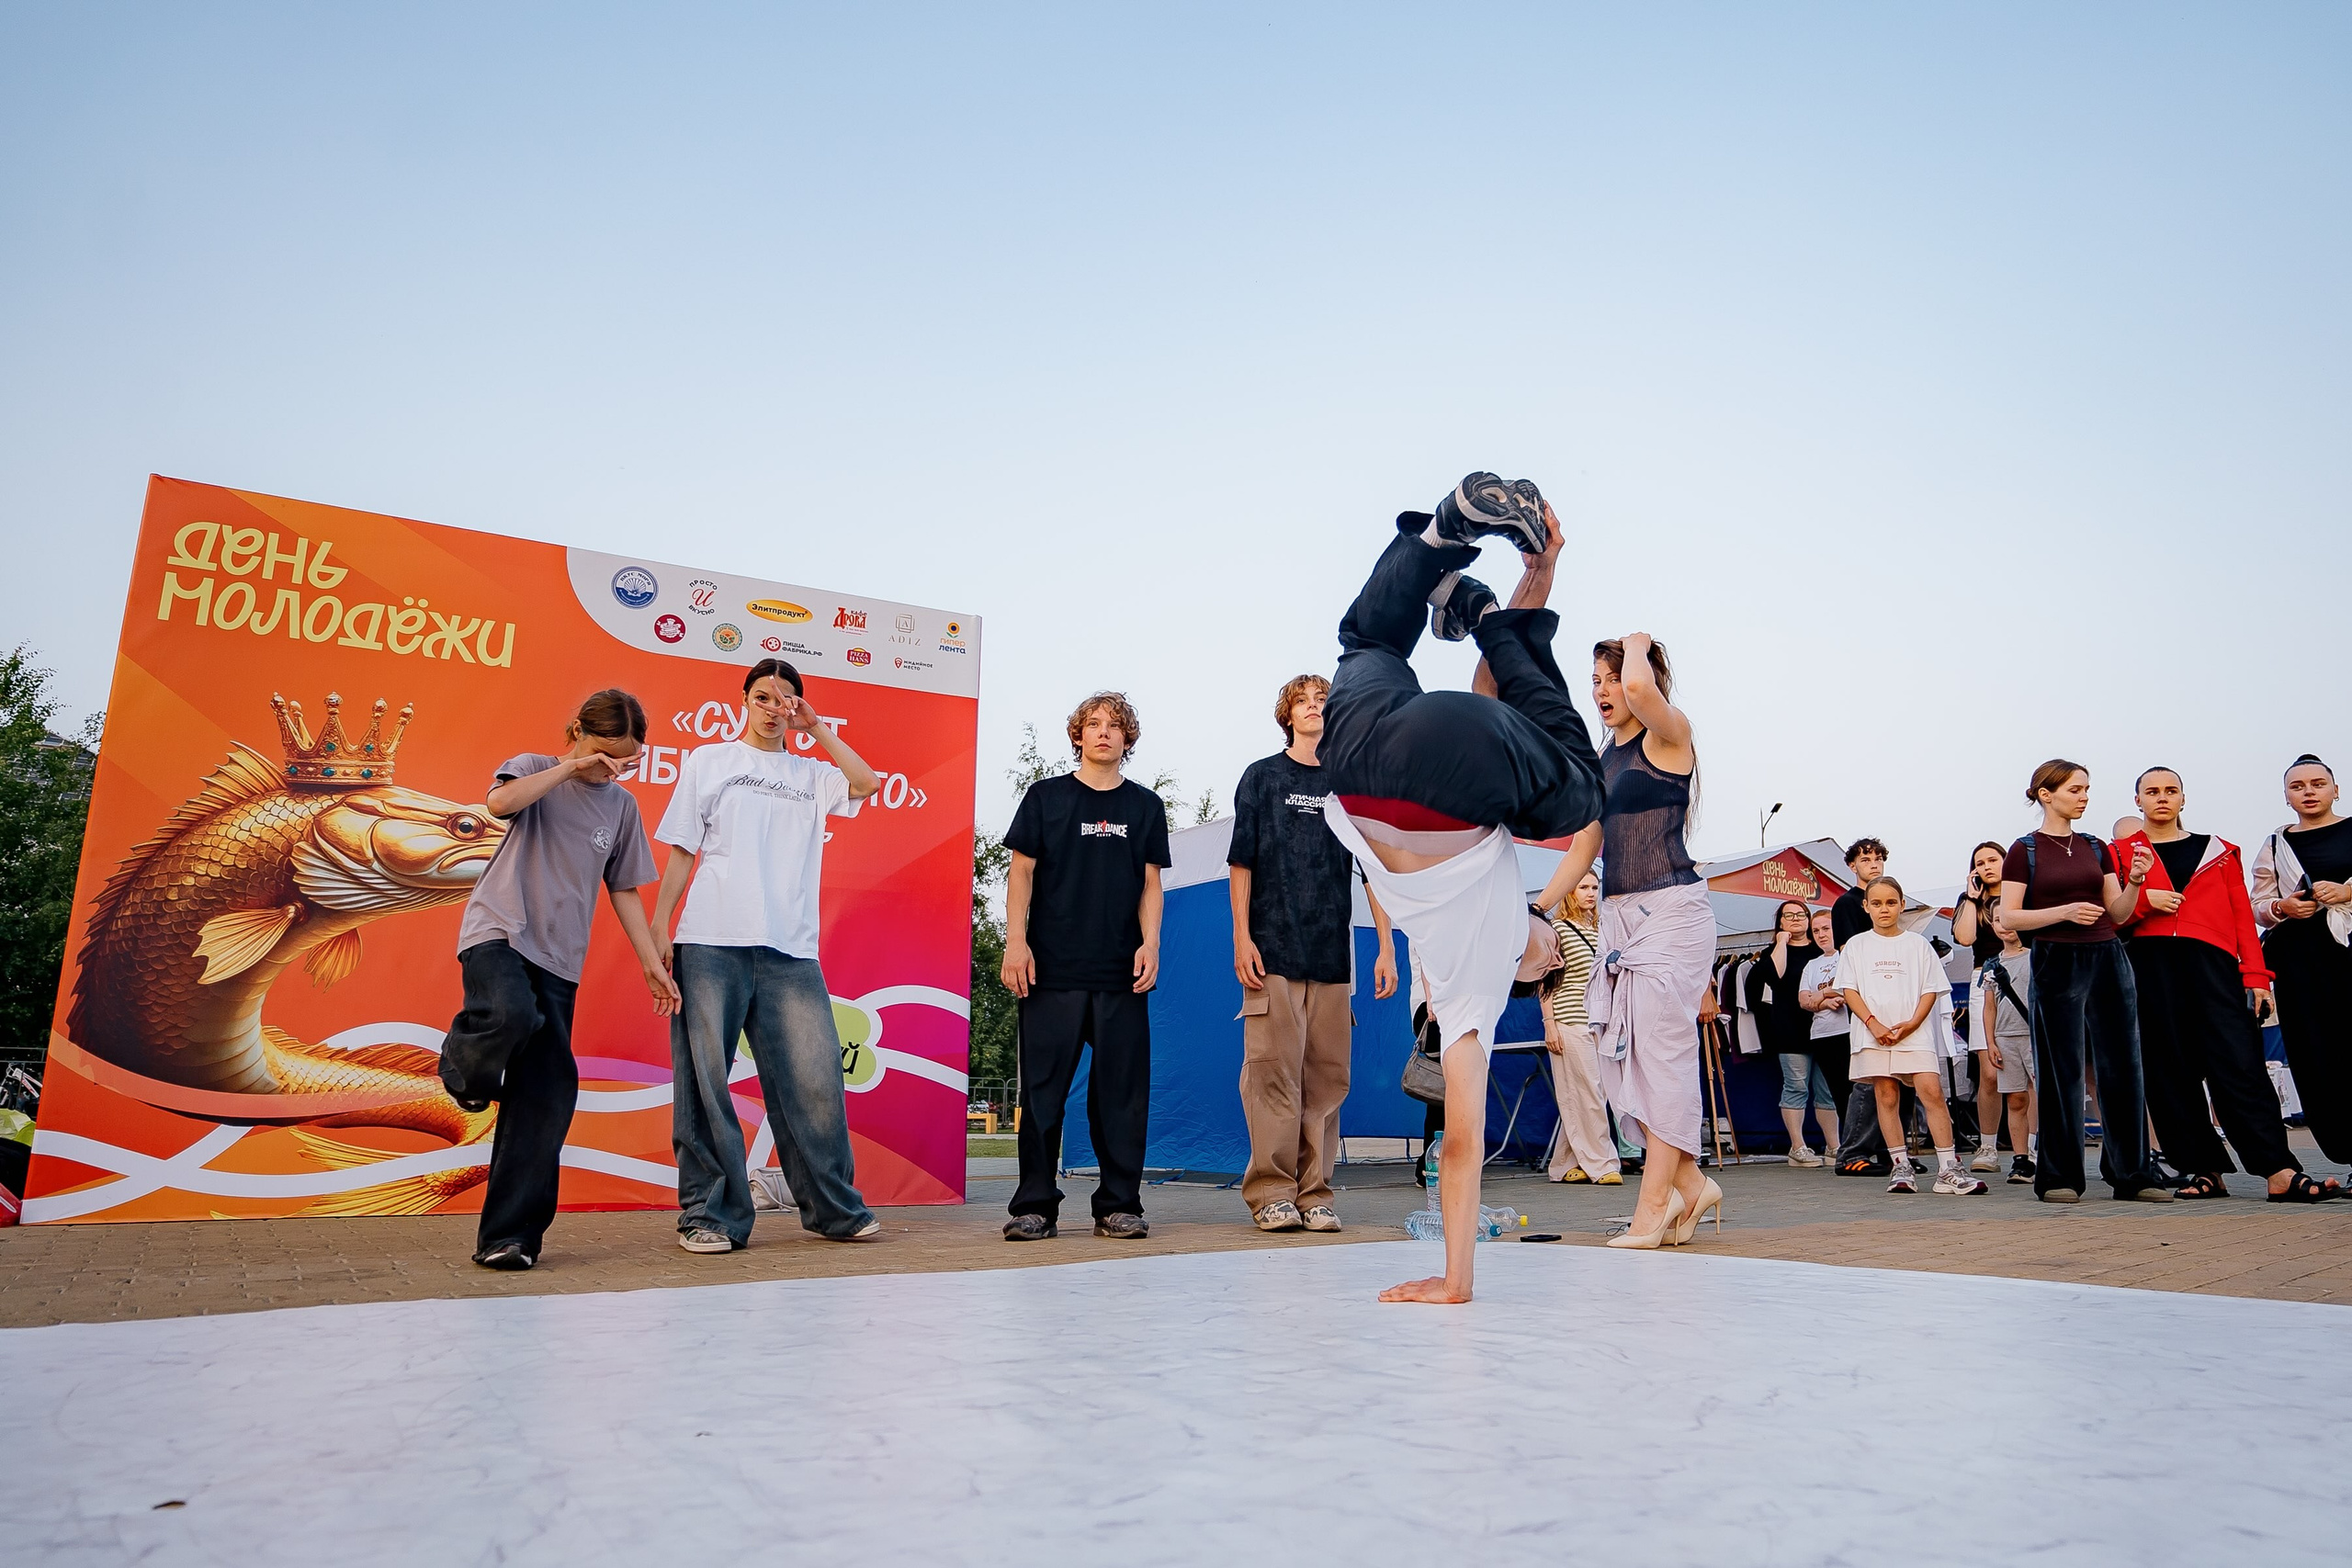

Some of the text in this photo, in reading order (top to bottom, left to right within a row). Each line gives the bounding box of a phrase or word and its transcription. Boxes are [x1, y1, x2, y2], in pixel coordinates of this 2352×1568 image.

[689, 580, 718, 591] ПРОСТО
[688, 604, 715, 615] ВКУСНО
[752, 604, 806, 618] Элитпродукт
[783, 640, 805, 649] ПИЦЦА
[888, 635, 922, 647] ADIZ
[940, 637, 967, 649] гипер
[782, 646, 823, 656] ФАБРИКА.РФ
[938, 644, 967, 654] лента
[850, 650, 868, 659] PIZZA
[849, 656, 869, 664] HANS
[903, 660, 933, 669] МИДИЙНОЕ
[726, 773, 765, 787] Bad
